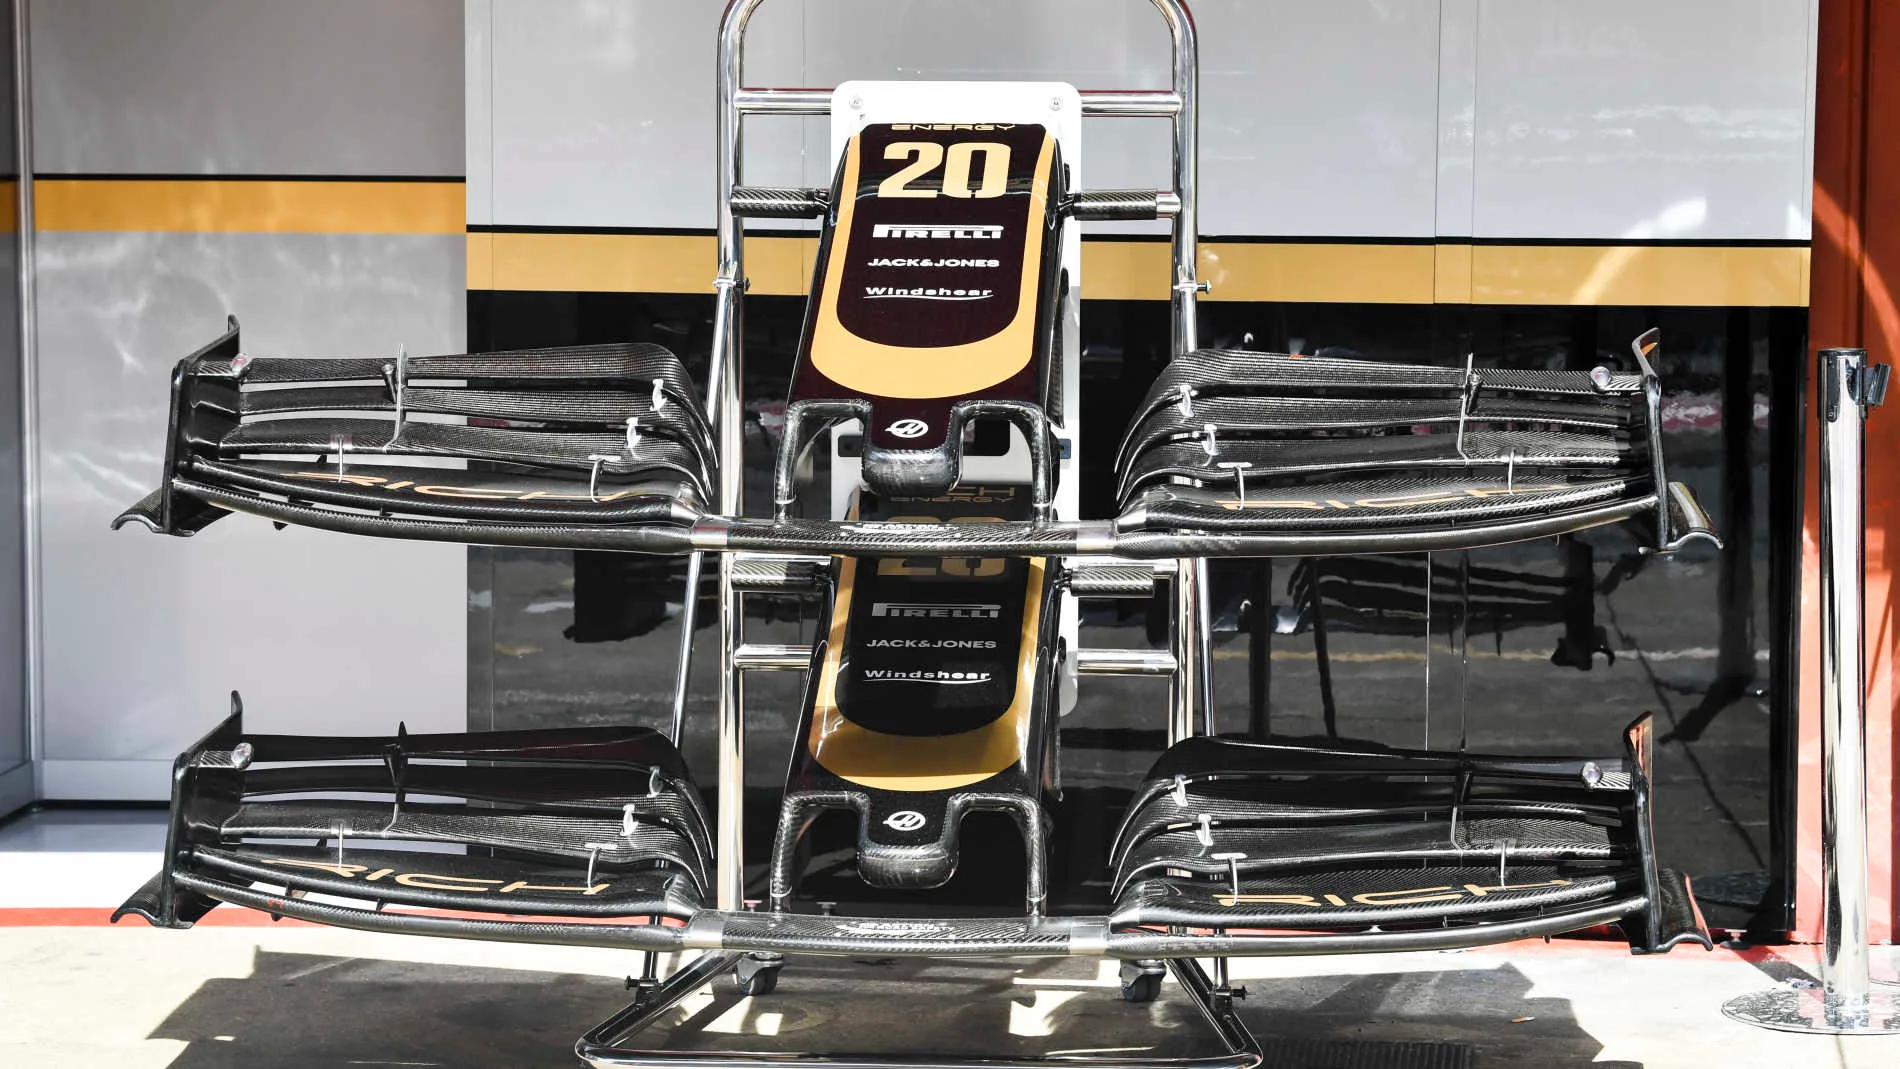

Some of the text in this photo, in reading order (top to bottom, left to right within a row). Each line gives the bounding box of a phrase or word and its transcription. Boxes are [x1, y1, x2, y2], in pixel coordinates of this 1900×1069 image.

[891, 123, 1016, 131] ENERGY
[878, 141, 1011, 198] 20
[872, 224, 1004, 239] PIRELLI
[867, 258, 1000, 268] JACK&JONES
[865, 286, 993, 298] Windshear
[871, 602, 1002, 618] PIRELLI
[866, 639, 997, 649] JACK&JONES
[864, 669, 992, 682] Windshear
[261, 858, 611, 896] RICH
[1212, 879, 1573, 906] RICH
